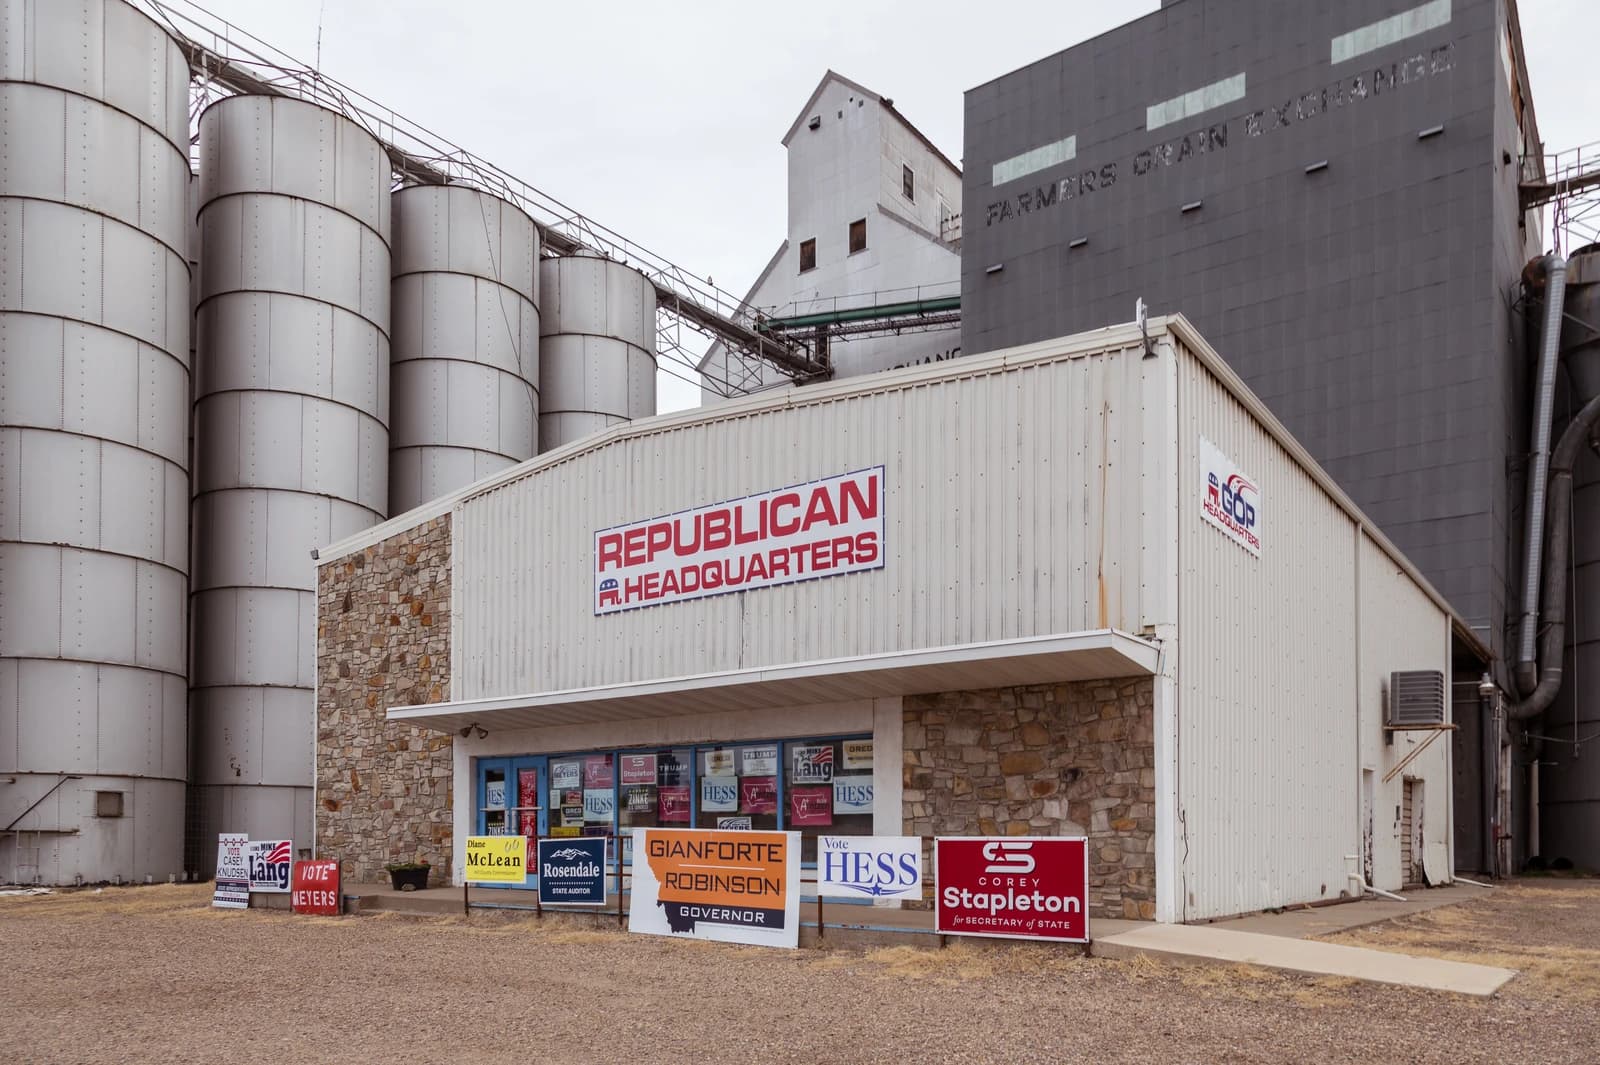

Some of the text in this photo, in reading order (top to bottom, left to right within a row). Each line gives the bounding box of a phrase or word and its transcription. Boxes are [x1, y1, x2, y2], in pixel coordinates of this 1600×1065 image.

[986, 42, 1456, 226] FARMERS GRAIN EXCHANGE
[1222, 482, 1255, 528] GOP
[600, 475, 877, 571] REPUBLICAN
[1204, 499, 1259, 550] HEADQUARTERS
[624, 531, 877, 603] HEADQUARTERS
[744, 752, 777, 760] TRUMP
[623, 771, 654, 779] Stapleton
[659, 764, 688, 772] TRUMP
[628, 794, 649, 805] ZINKE
[704, 785, 736, 801] HESS
[836, 785, 873, 802] HESS
[585, 797, 613, 811] HESS
[261, 843, 276, 851] MIKE
[467, 840, 486, 848] Diane
[825, 837, 849, 849] Vote
[227, 848, 240, 856] VOTE
[650, 840, 783, 862] GIANFORTE
[223, 856, 243, 866] CASEY
[467, 852, 521, 867] McLean
[218, 867, 248, 878] KNUDSEN
[249, 855, 290, 889] Lang
[302, 865, 329, 880] VOTE
[543, 861, 600, 878] Rosendale
[824, 852, 918, 885] HESS
[666, 872, 780, 896] ROBINSON
[978, 877, 1040, 888] COREY
[293, 891, 335, 907] MEYERS
[943, 886, 1080, 916] Stapleton
[680, 906, 765, 923] GOVERNOR
[952, 915, 1070, 930] for SECRETARY of STATE
